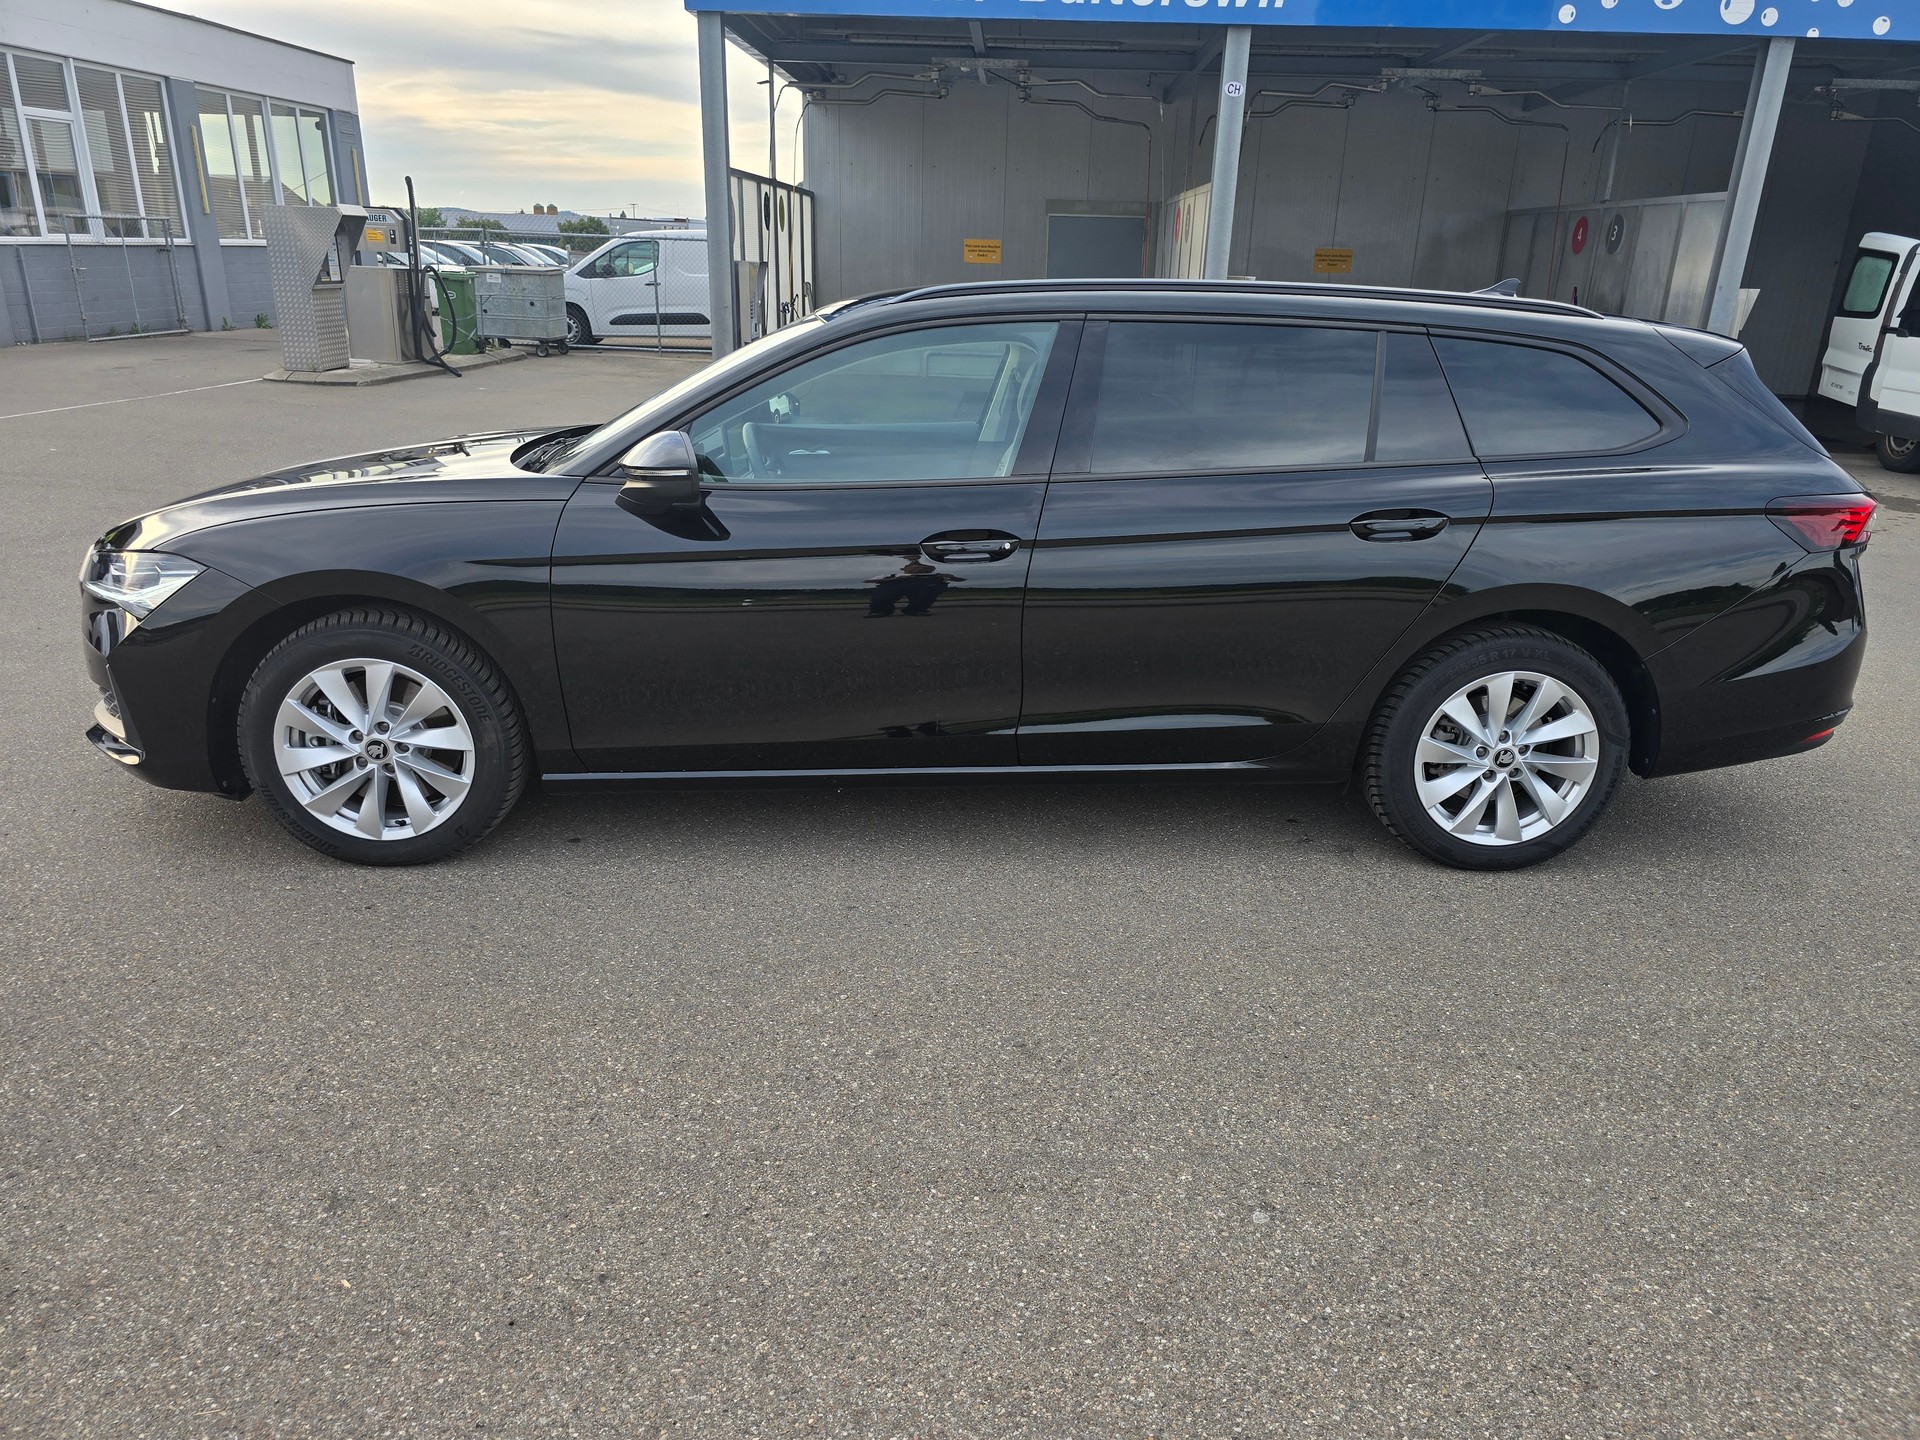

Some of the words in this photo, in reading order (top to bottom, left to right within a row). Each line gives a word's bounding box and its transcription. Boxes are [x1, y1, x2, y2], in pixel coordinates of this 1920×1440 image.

[1227, 83, 1241, 95] CH
[1577, 227, 1583, 242] 4
[1611, 225, 1618, 241] 3
[1502, 647, 1516, 660] 17
[406, 644, 492, 723] BRIDGESTONE
[256, 781, 341, 855] BRIDGESTONE
